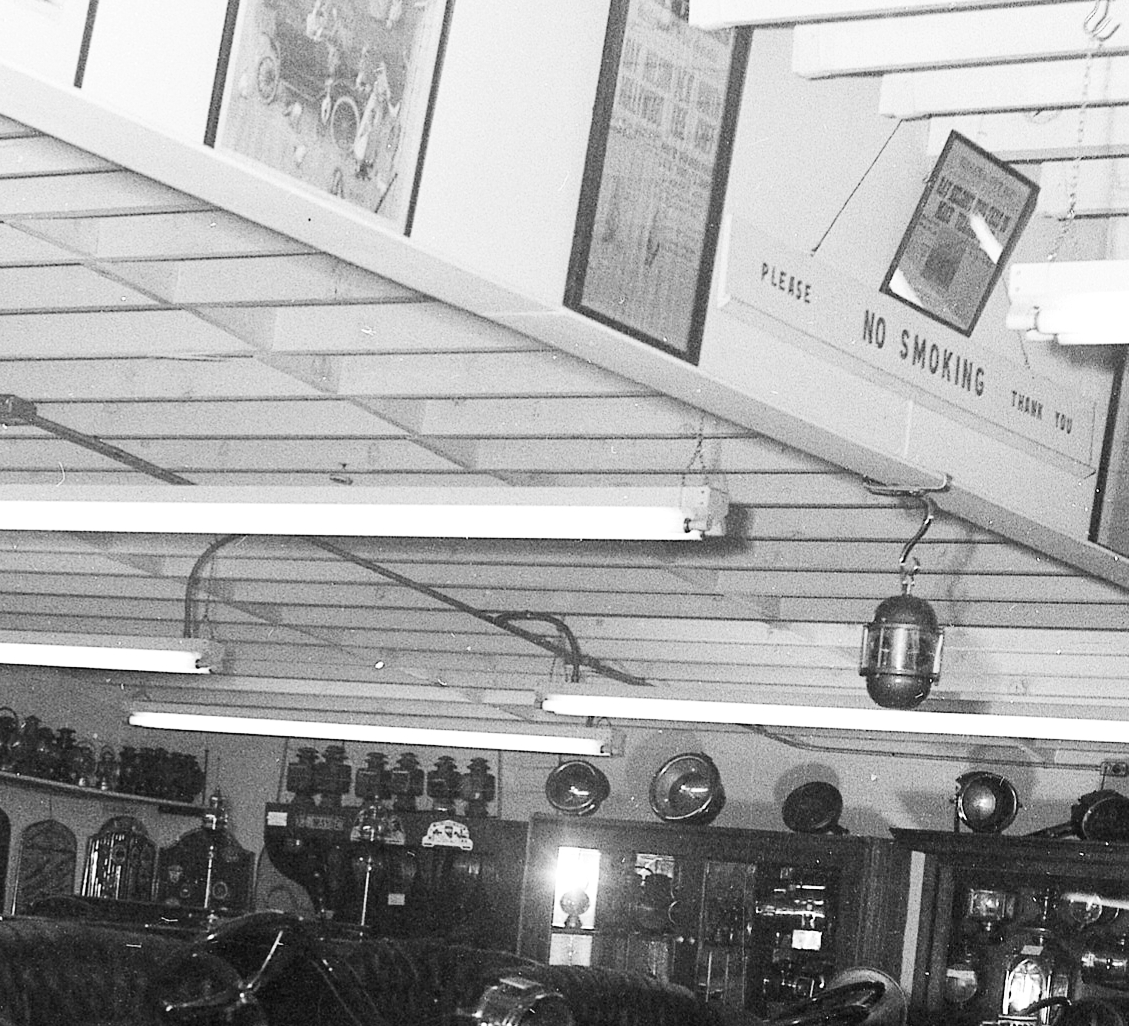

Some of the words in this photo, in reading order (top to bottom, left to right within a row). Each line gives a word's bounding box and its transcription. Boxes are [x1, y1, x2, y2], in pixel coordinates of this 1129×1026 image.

[762, 262, 812, 304] PLEASE
[863, 309, 886, 349] NO
[900, 329, 985, 397] SMOKING
[1012, 390, 1043, 420] THANK
[1055, 411, 1073, 435] YOU
